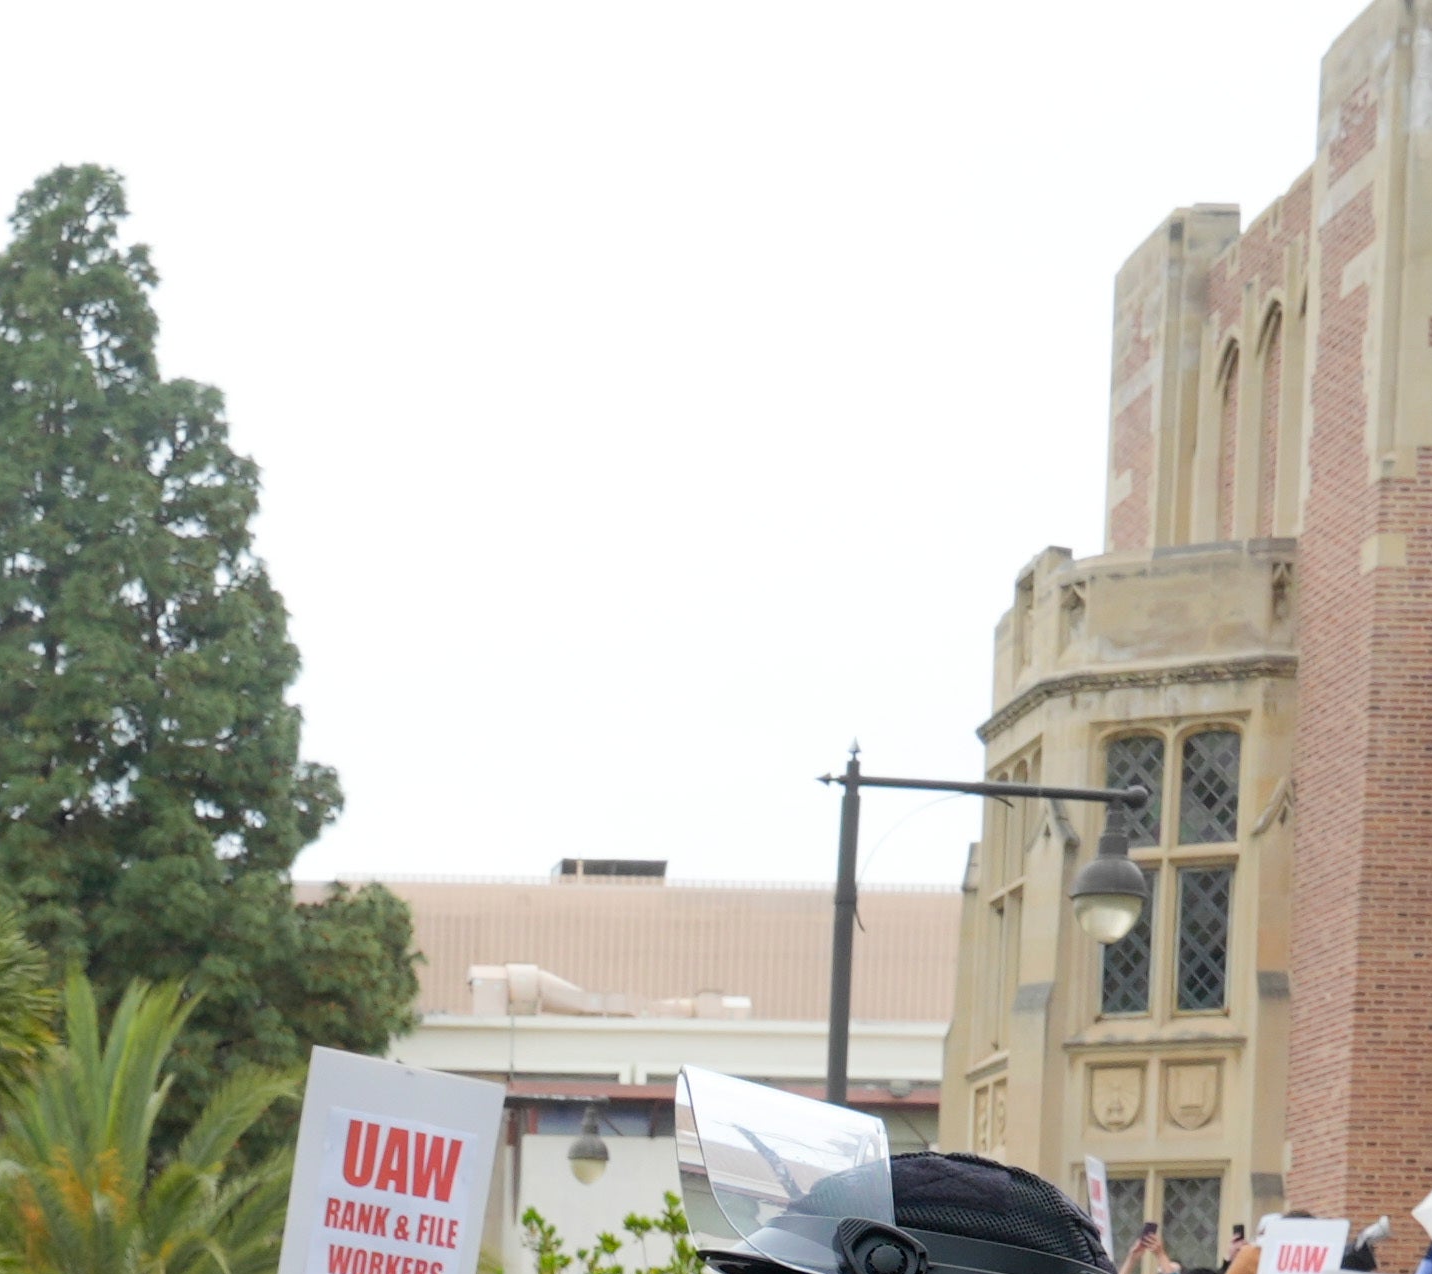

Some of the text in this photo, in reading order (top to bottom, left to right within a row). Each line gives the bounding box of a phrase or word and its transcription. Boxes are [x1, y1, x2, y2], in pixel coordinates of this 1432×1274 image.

[342, 1119, 463, 1203] UAW
[324, 1198, 459, 1250] RANK & FILE
[1276, 1244, 1329, 1273] UAW
